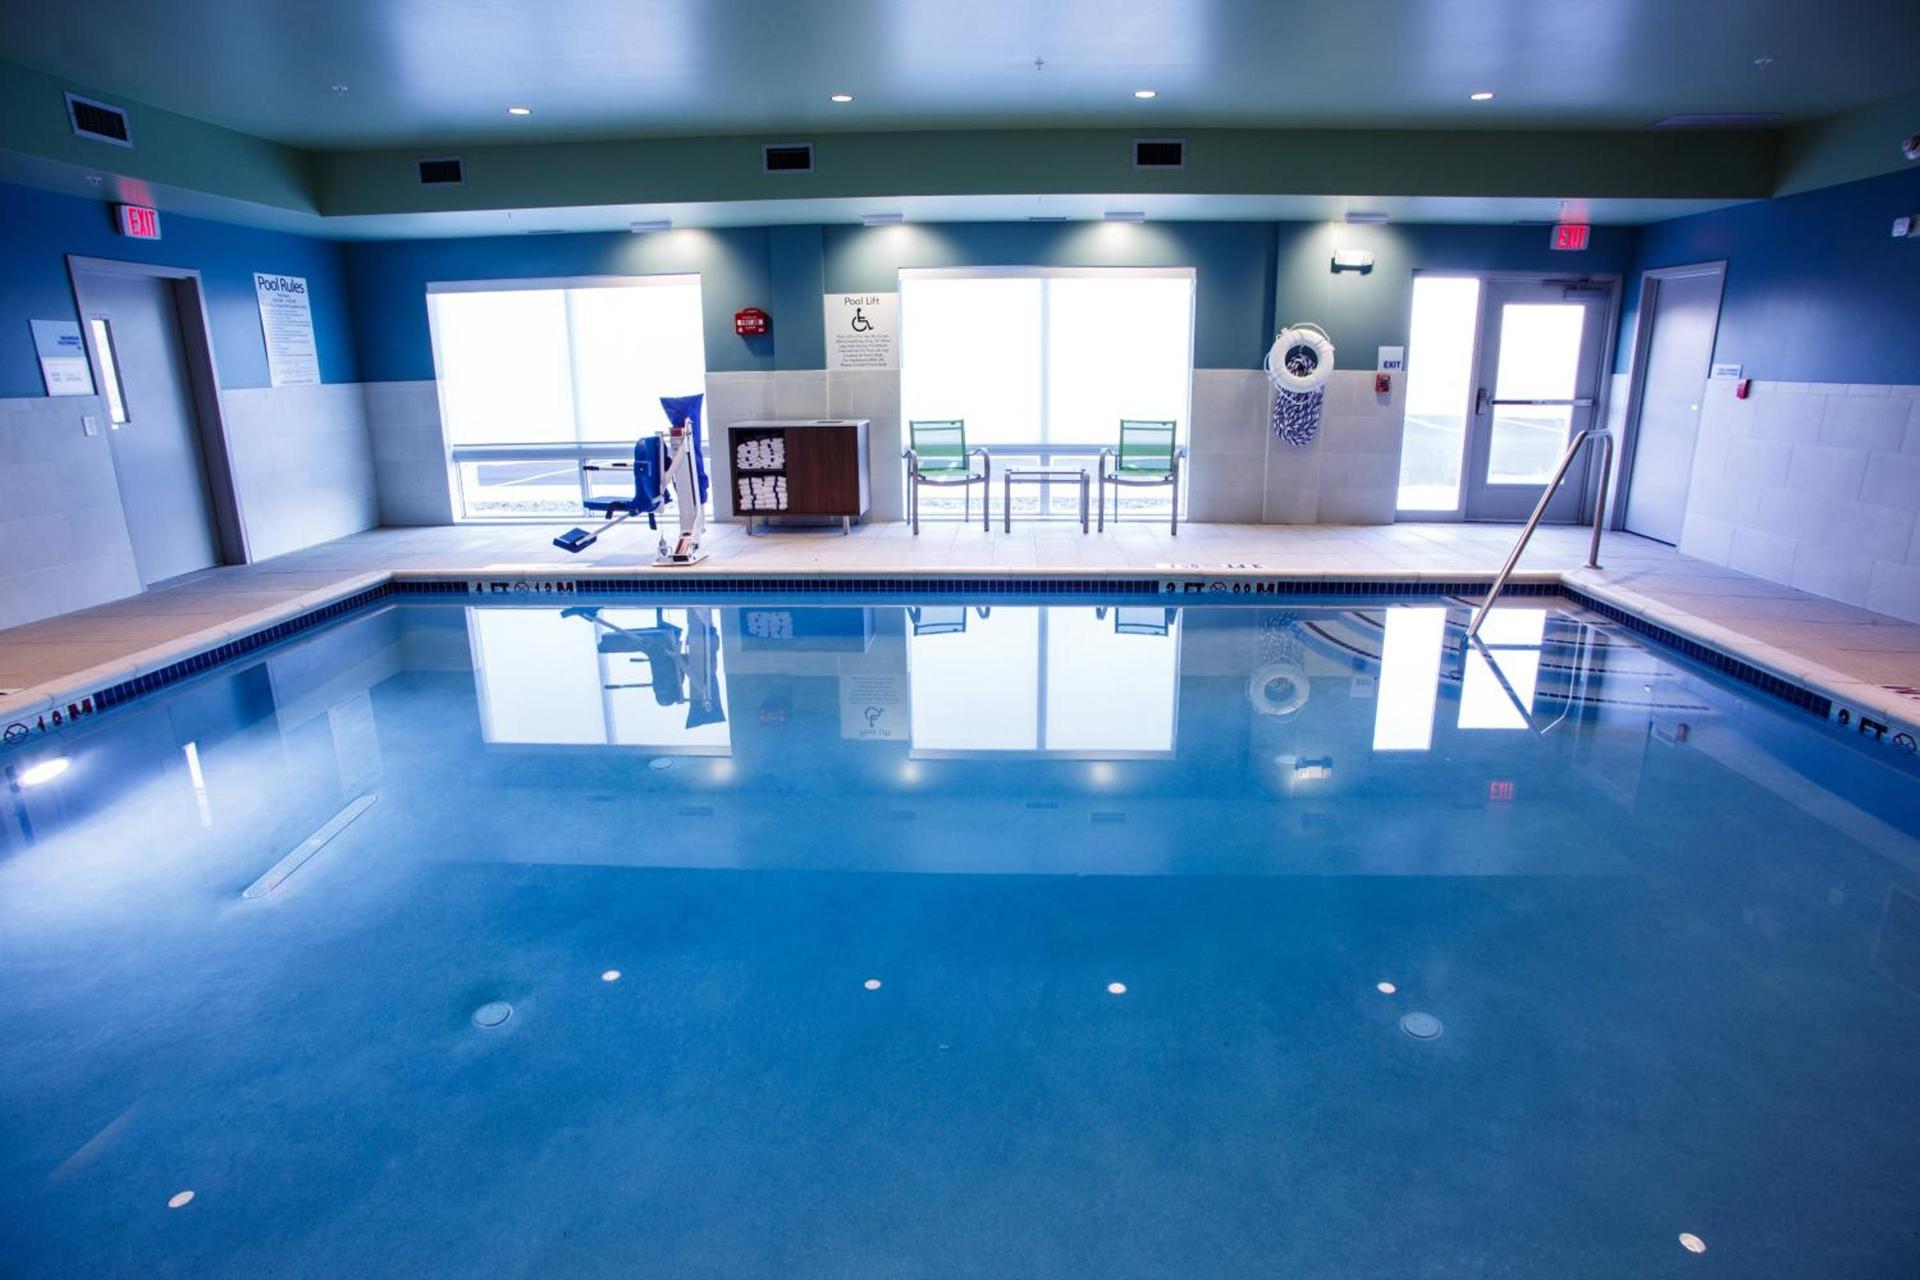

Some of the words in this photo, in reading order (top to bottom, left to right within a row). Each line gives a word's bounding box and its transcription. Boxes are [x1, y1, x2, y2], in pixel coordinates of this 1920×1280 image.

[127, 207, 156, 237] EXIT
[1557, 224, 1586, 249] EXIT
[257, 276, 280, 291] Pool
[280, 278, 305, 294] Rules
[844, 296, 863, 305] Pool
[866, 296, 880, 305] Lift
[1383, 360, 1401, 369] EXIT
[490, 582, 509, 593] FT
